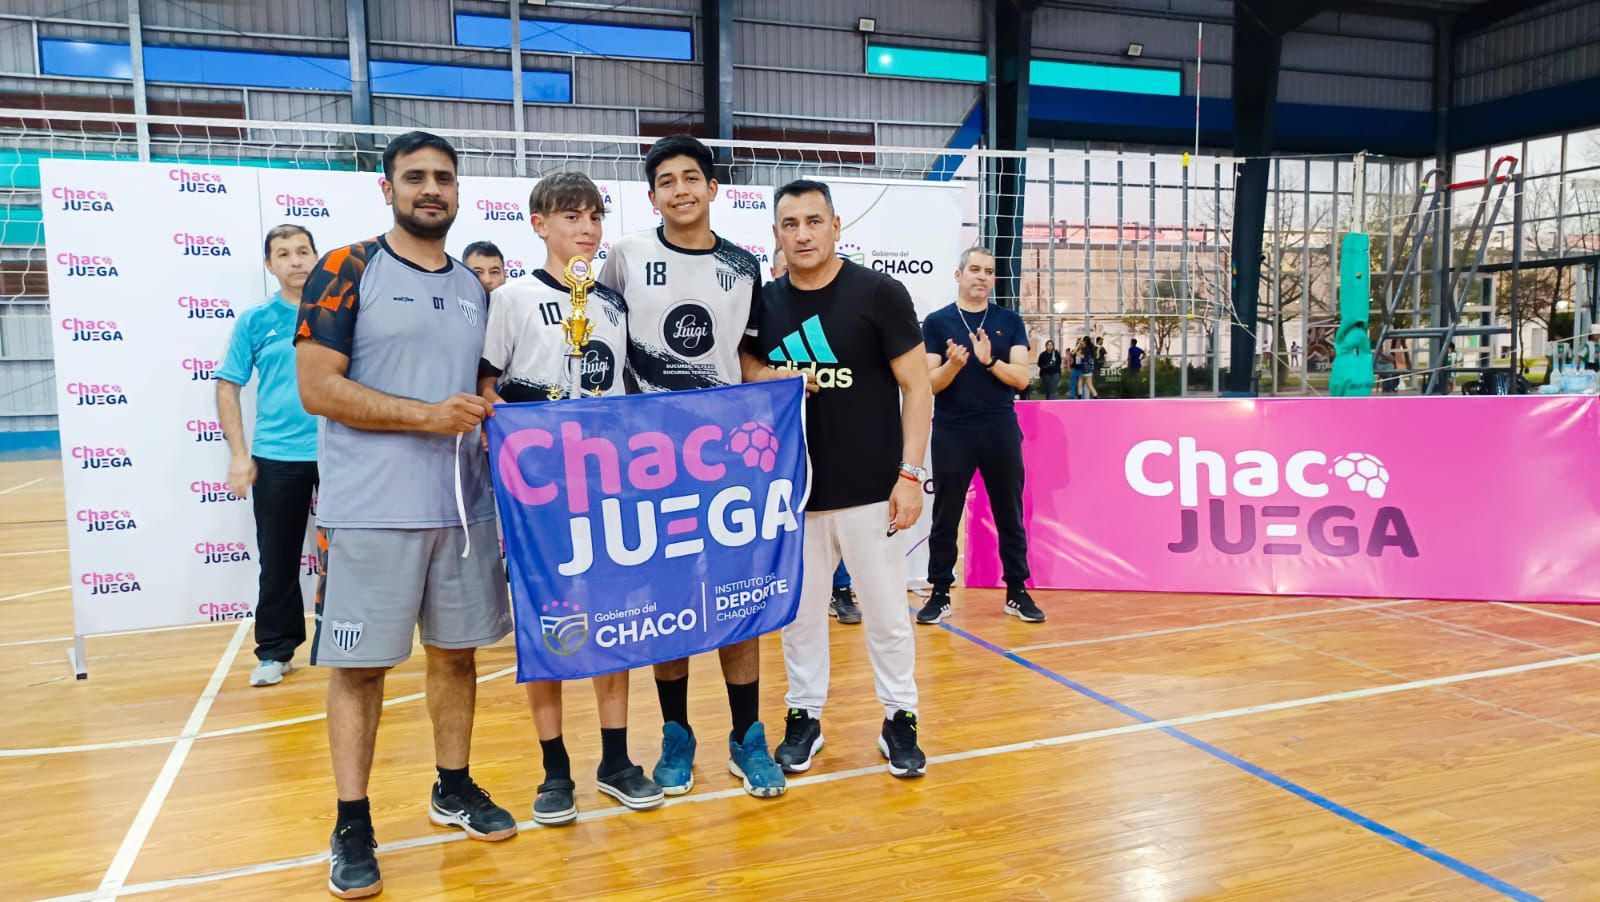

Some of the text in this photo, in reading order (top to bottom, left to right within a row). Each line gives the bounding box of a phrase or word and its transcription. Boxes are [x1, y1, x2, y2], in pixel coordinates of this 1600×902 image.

[178, 182, 226, 193] JUEGA
[63, 200, 113, 211] JUEGA
[732, 200, 766, 209] JUEGA
[285, 207, 329, 217] JUEGA
[484, 211, 523, 220] JUEGA
[183, 245, 230, 256] JUEGA
[67, 266, 118, 276] JUEGA
[645, 261, 666, 285] 18
[872, 260, 934, 274] CHACO
[433, 296, 444, 310] DT
[187, 308, 235, 318] JUEGA
[539, 302, 563, 326] 10
[72, 330, 123, 341] JUEGA
[673, 314, 708, 349] Luigi
[77, 395, 127, 405] JUEGA
[81, 458, 132, 469] JUEGA
[86, 520, 136, 532] JUEGA
[558, 479, 799, 577] JUEGA
[1167, 498, 1420, 558] JUEGA
[203, 552, 250, 564] JUEGA
[91, 582, 140, 595] JUEGA
[715, 577, 764, 594] INSTITUTO
[715, 579, 789, 611] DEPORTE
[594, 602, 657, 623] Gobierno del
[595, 608, 698, 648] CHACO
